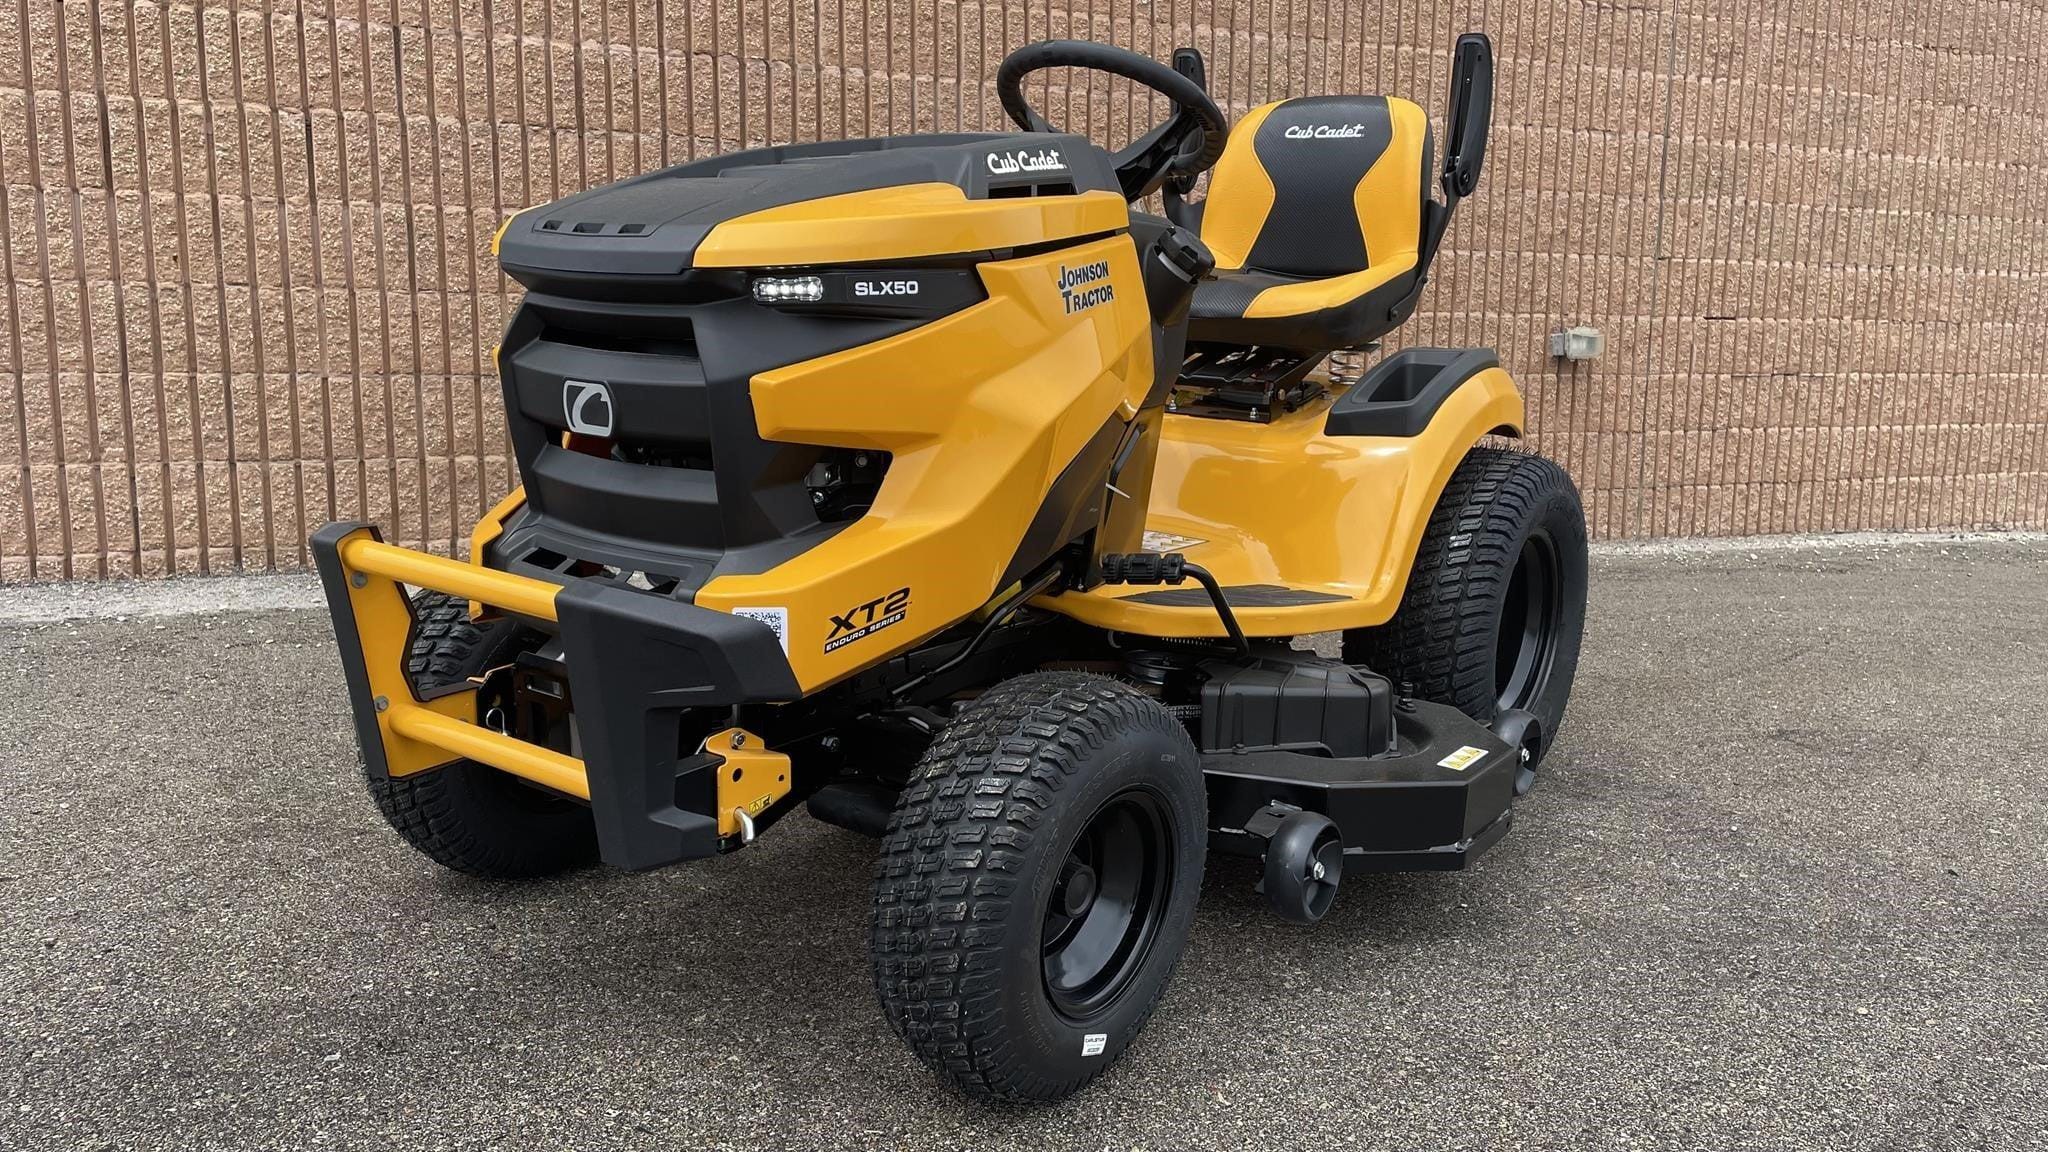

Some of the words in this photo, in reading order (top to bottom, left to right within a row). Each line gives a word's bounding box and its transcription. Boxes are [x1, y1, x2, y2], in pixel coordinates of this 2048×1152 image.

[1285, 125, 1313, 138] Cub
[1314, 124, 1364, 138] Cadet
[987, 151, 1020, 174] Cub
[1018, 149, 1065, 171] Cadet
[854, 280, 919, 297] SLX50
[1058, 261, 1109, 290] JOHNSON
[1062, 285, 1114, 314] TRACTOR
[825, 586, 911, 641] XT2
[825, 629, 867, 652] ENDURO
[869, 613, 902, 632] SERIES
